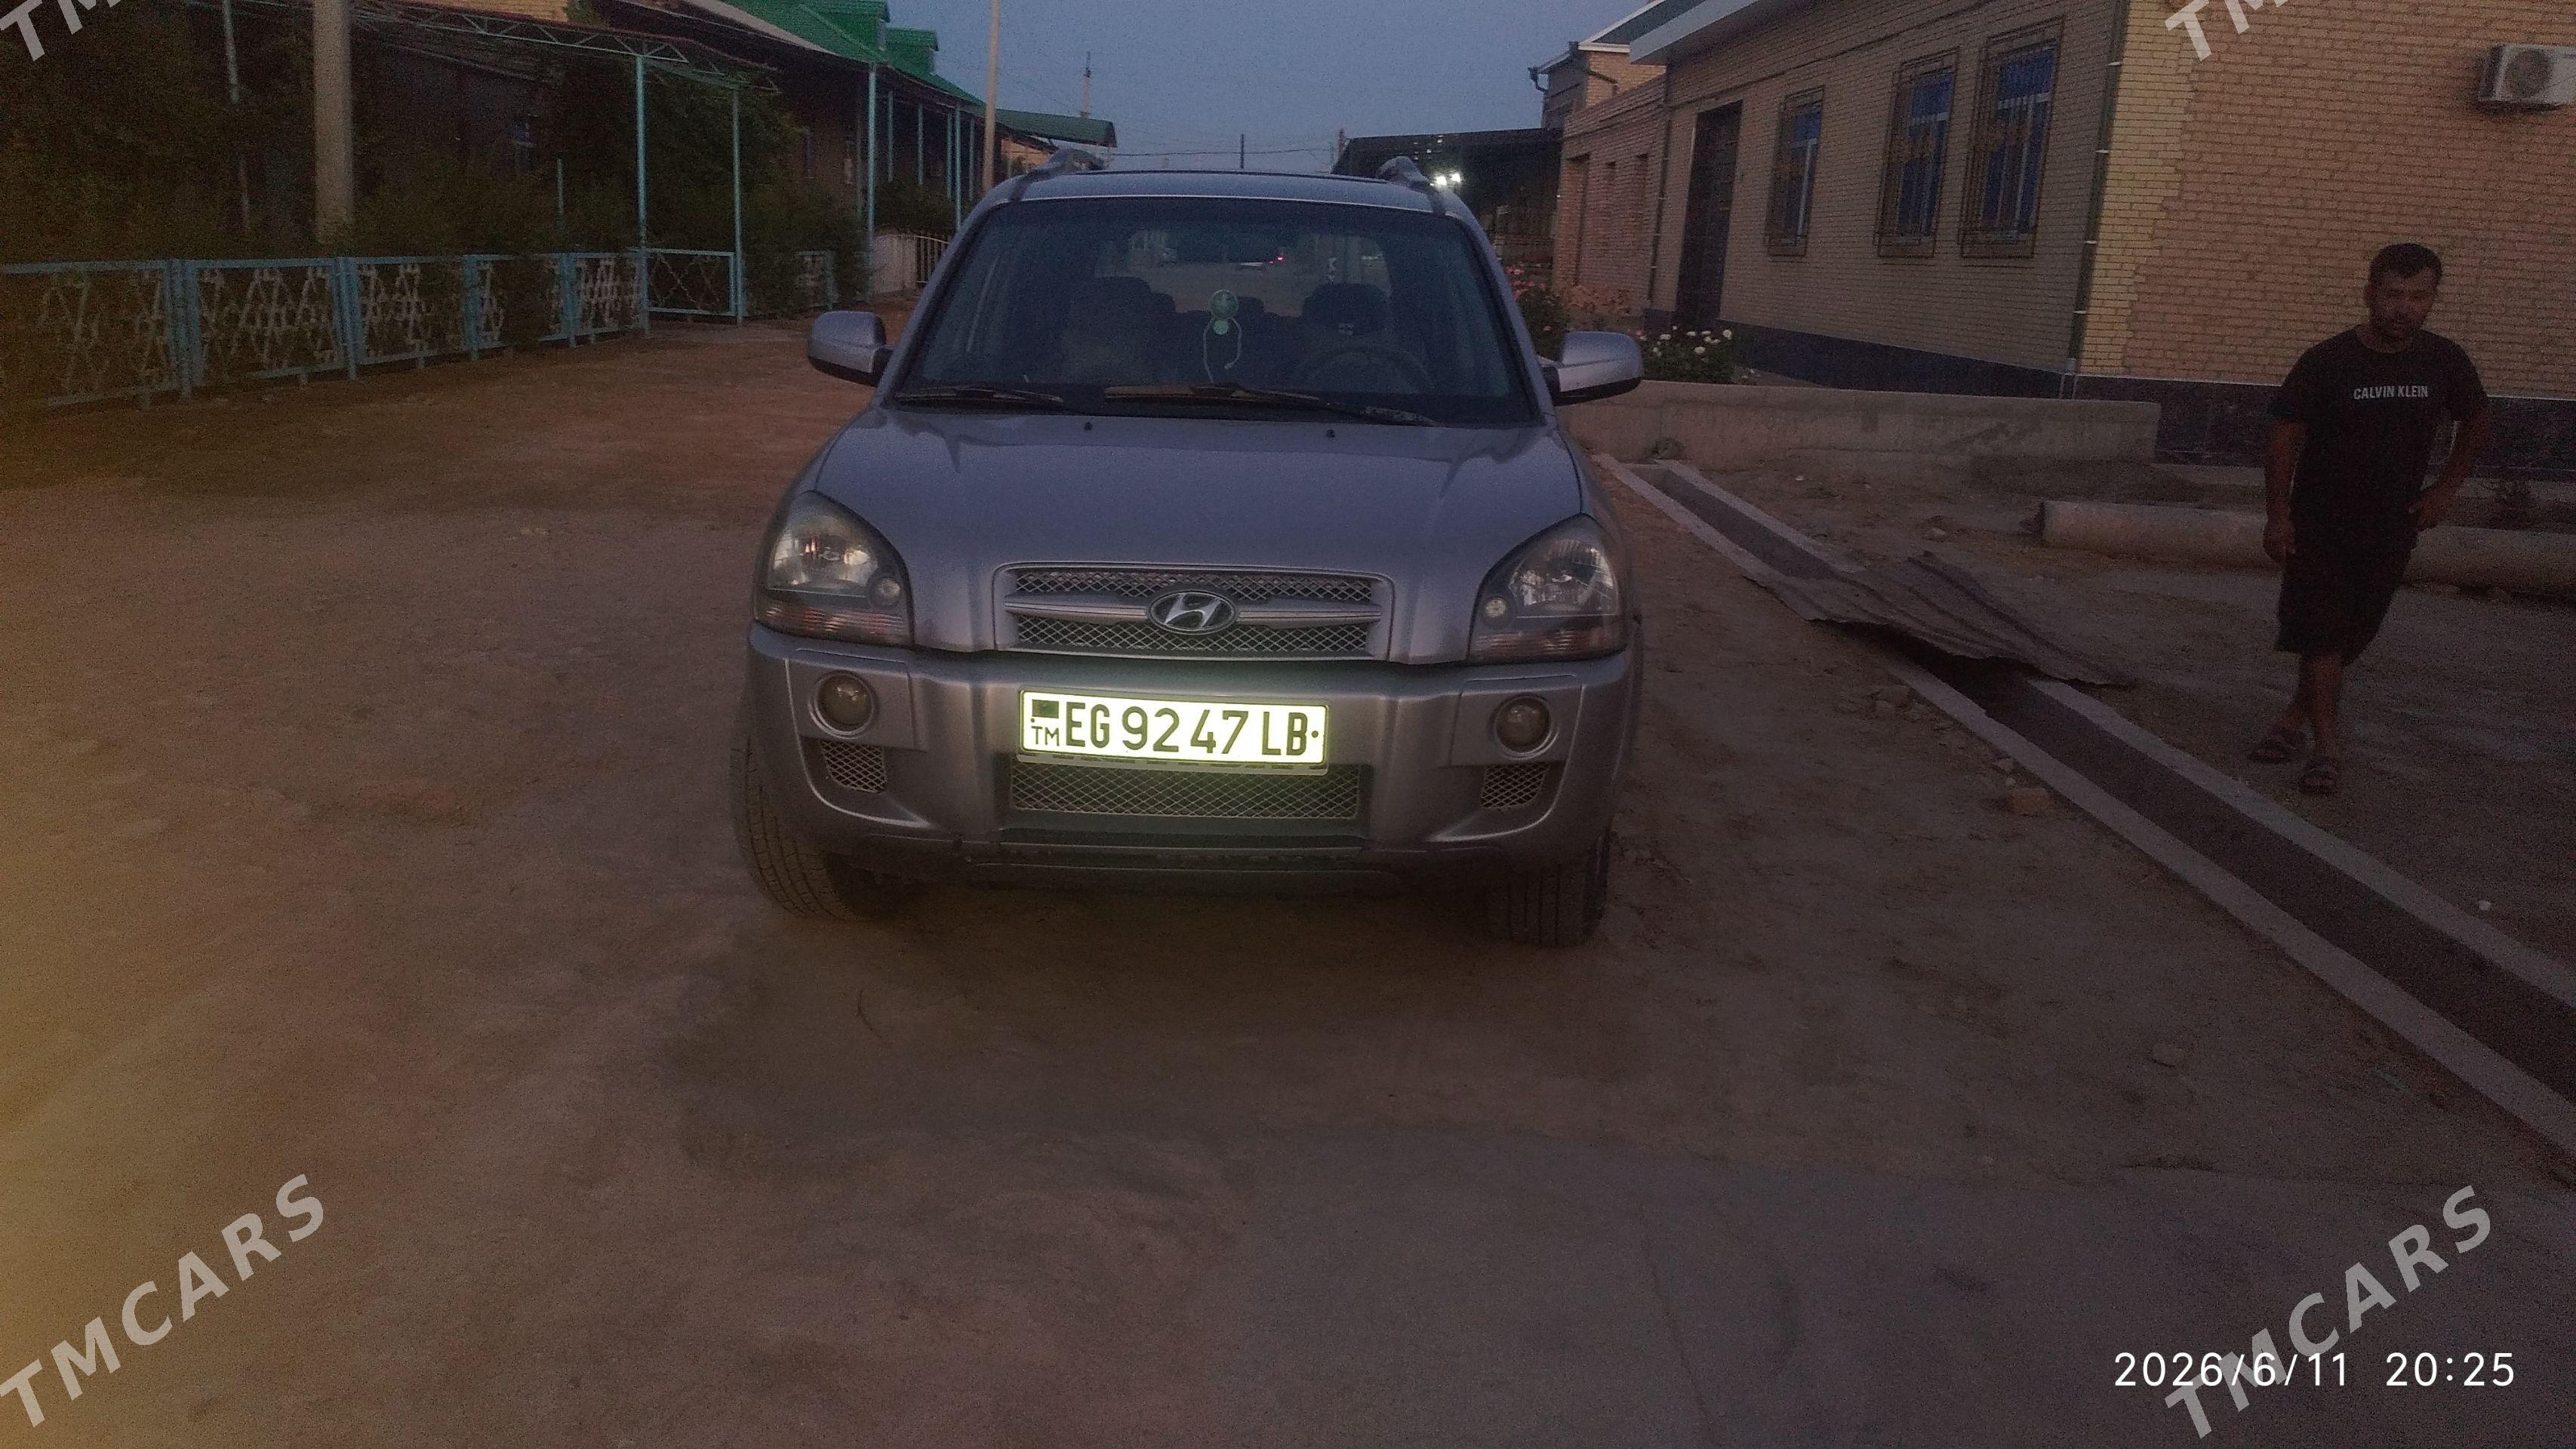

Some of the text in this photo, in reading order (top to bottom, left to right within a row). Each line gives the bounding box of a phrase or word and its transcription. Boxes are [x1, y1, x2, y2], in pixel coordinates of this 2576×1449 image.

[2353, 385, 2429, 400] CALVIN KLEIN
[1031, 725, 1060, 746] TM
[1066, 702, 1110, 749] EG
[1261, 712, 1308, 755] LB
